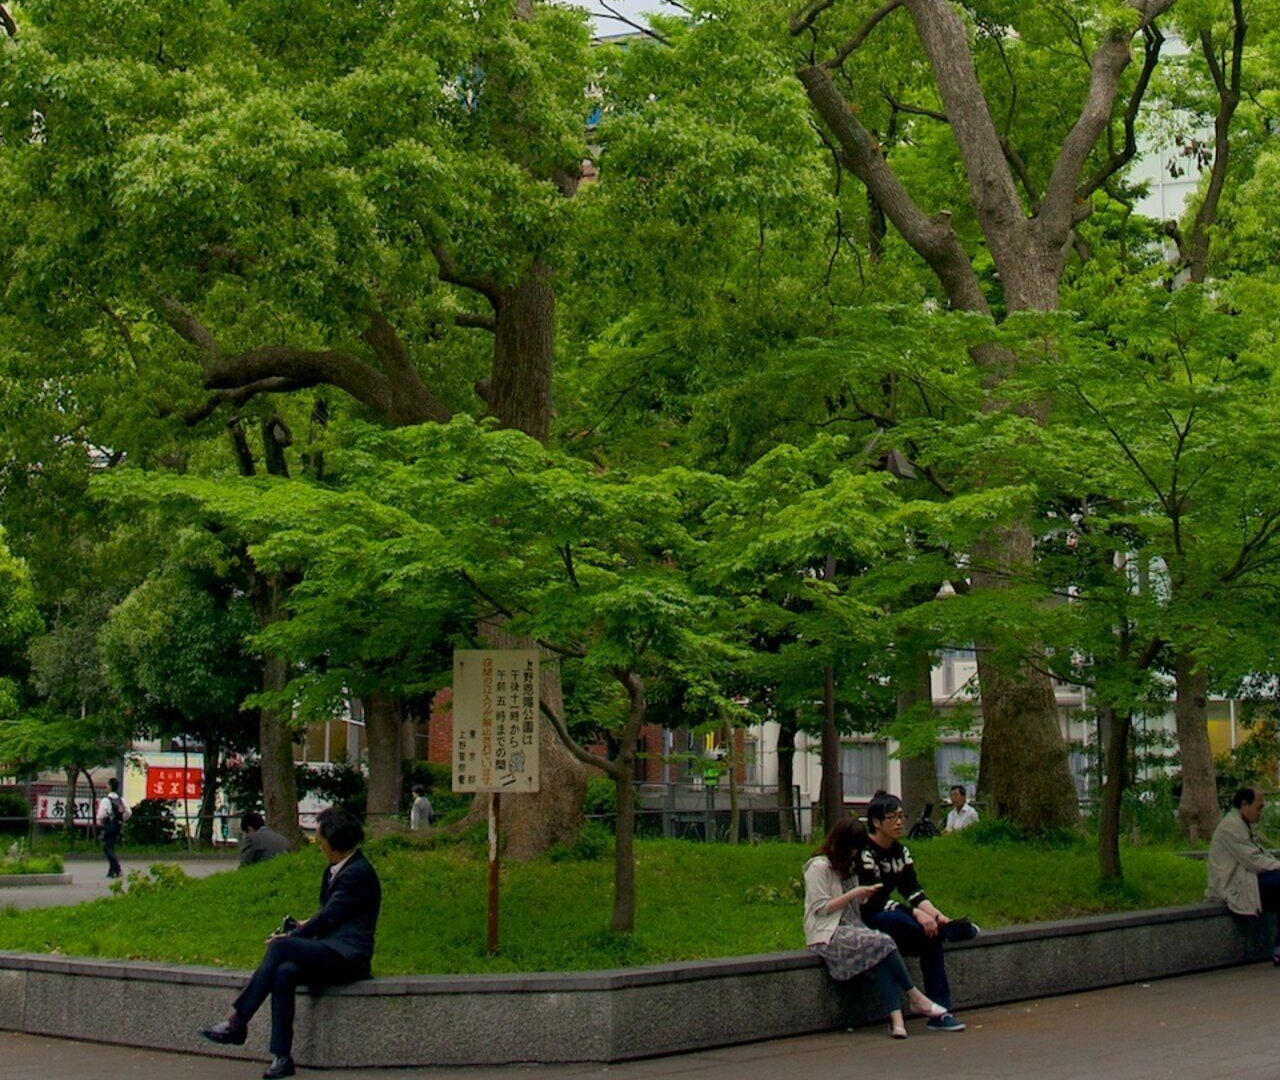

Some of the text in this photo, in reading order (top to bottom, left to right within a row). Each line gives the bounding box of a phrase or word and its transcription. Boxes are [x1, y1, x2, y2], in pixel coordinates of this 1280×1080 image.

[510, 669, 520, 748] 午後十一時から
